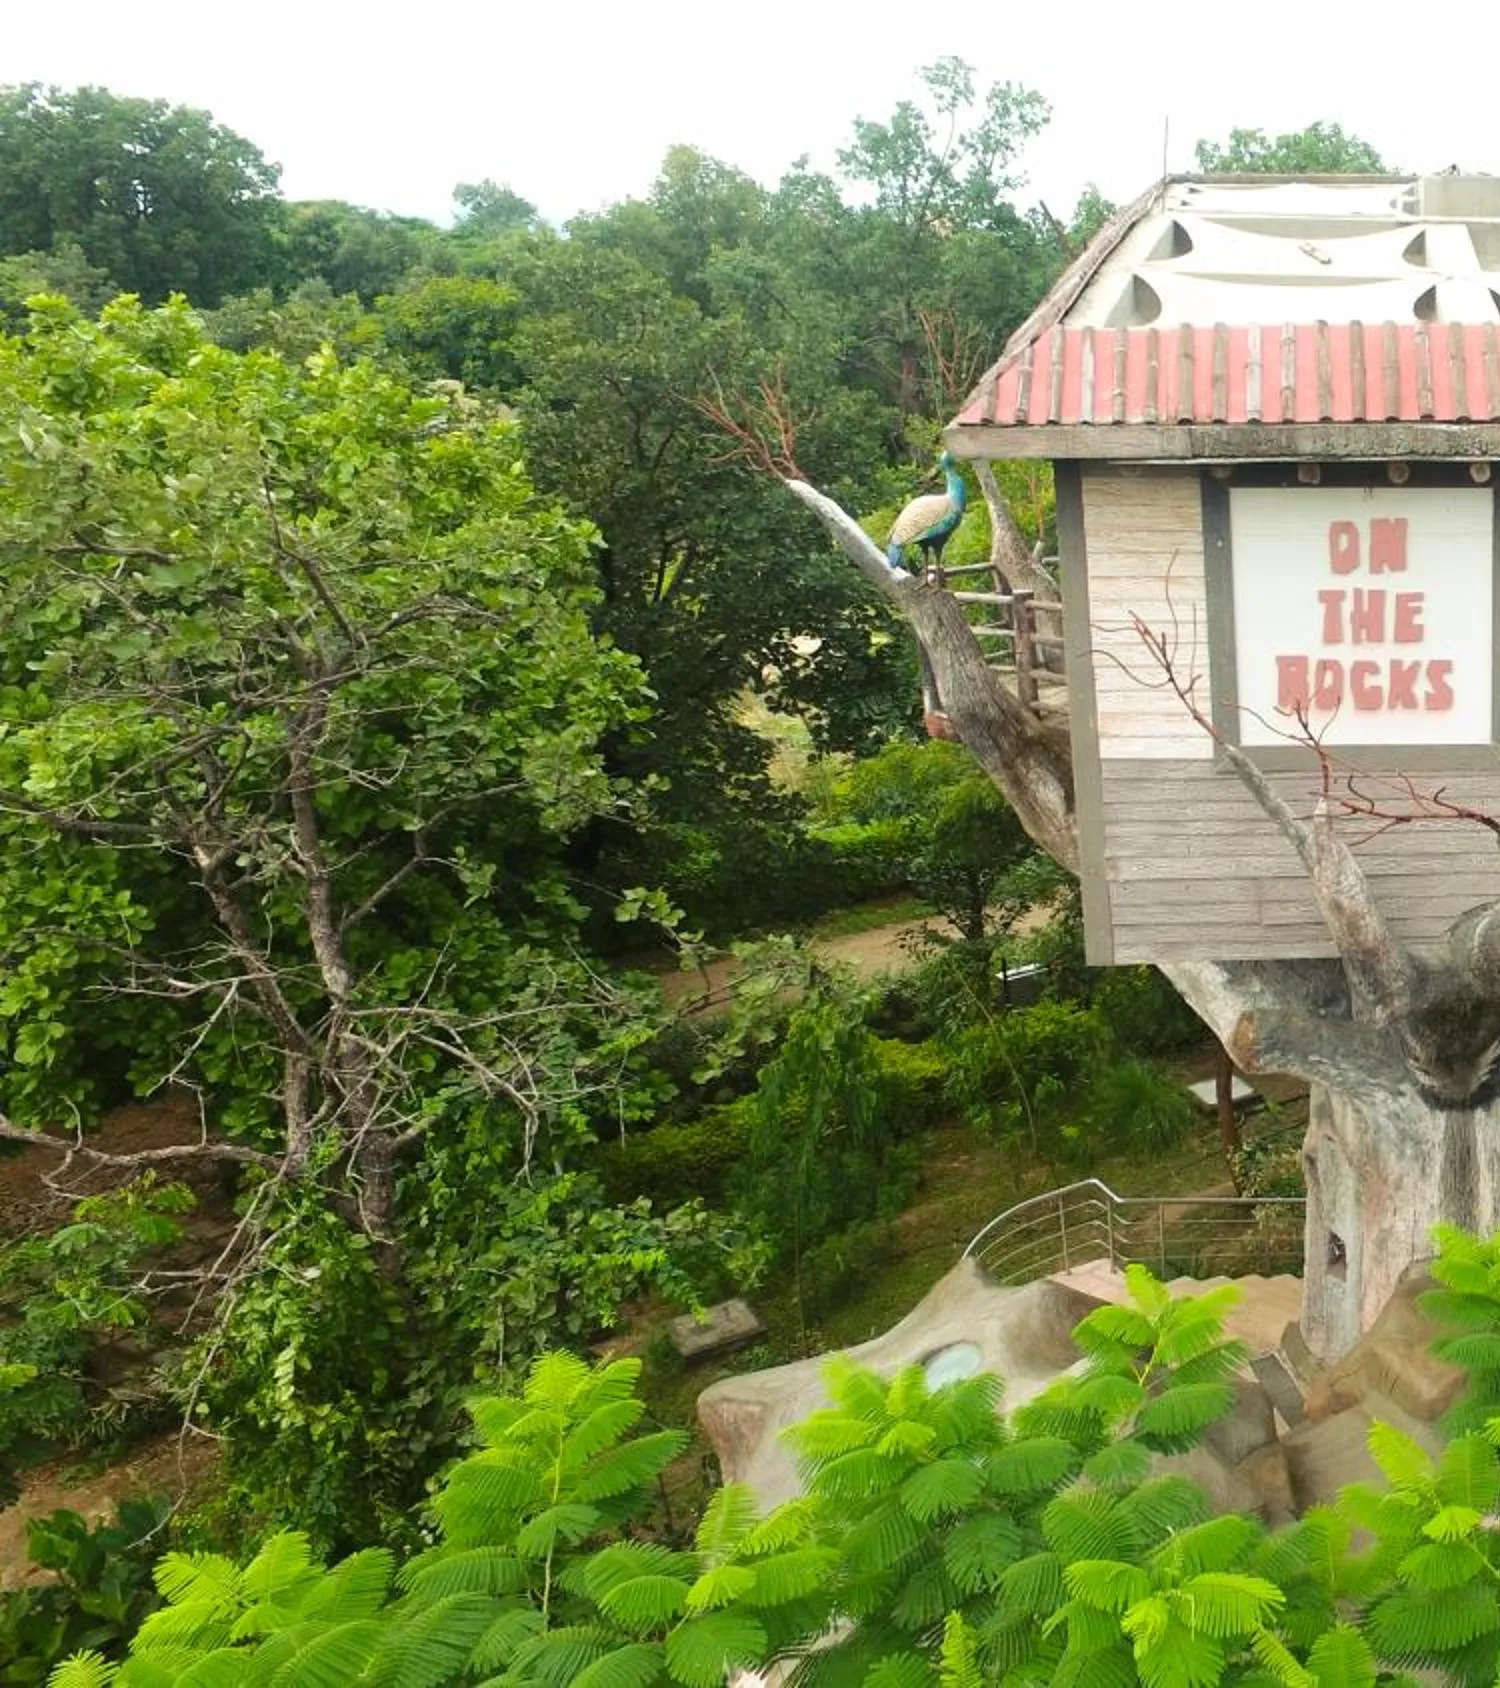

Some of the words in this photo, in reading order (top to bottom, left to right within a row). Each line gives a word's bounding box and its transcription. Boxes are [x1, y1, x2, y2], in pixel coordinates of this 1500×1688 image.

[1329, 518, 1408, 575] ON
[1318, 588, 1424, 644] THE
[1276, 655, 1454, 711] ROCKS
